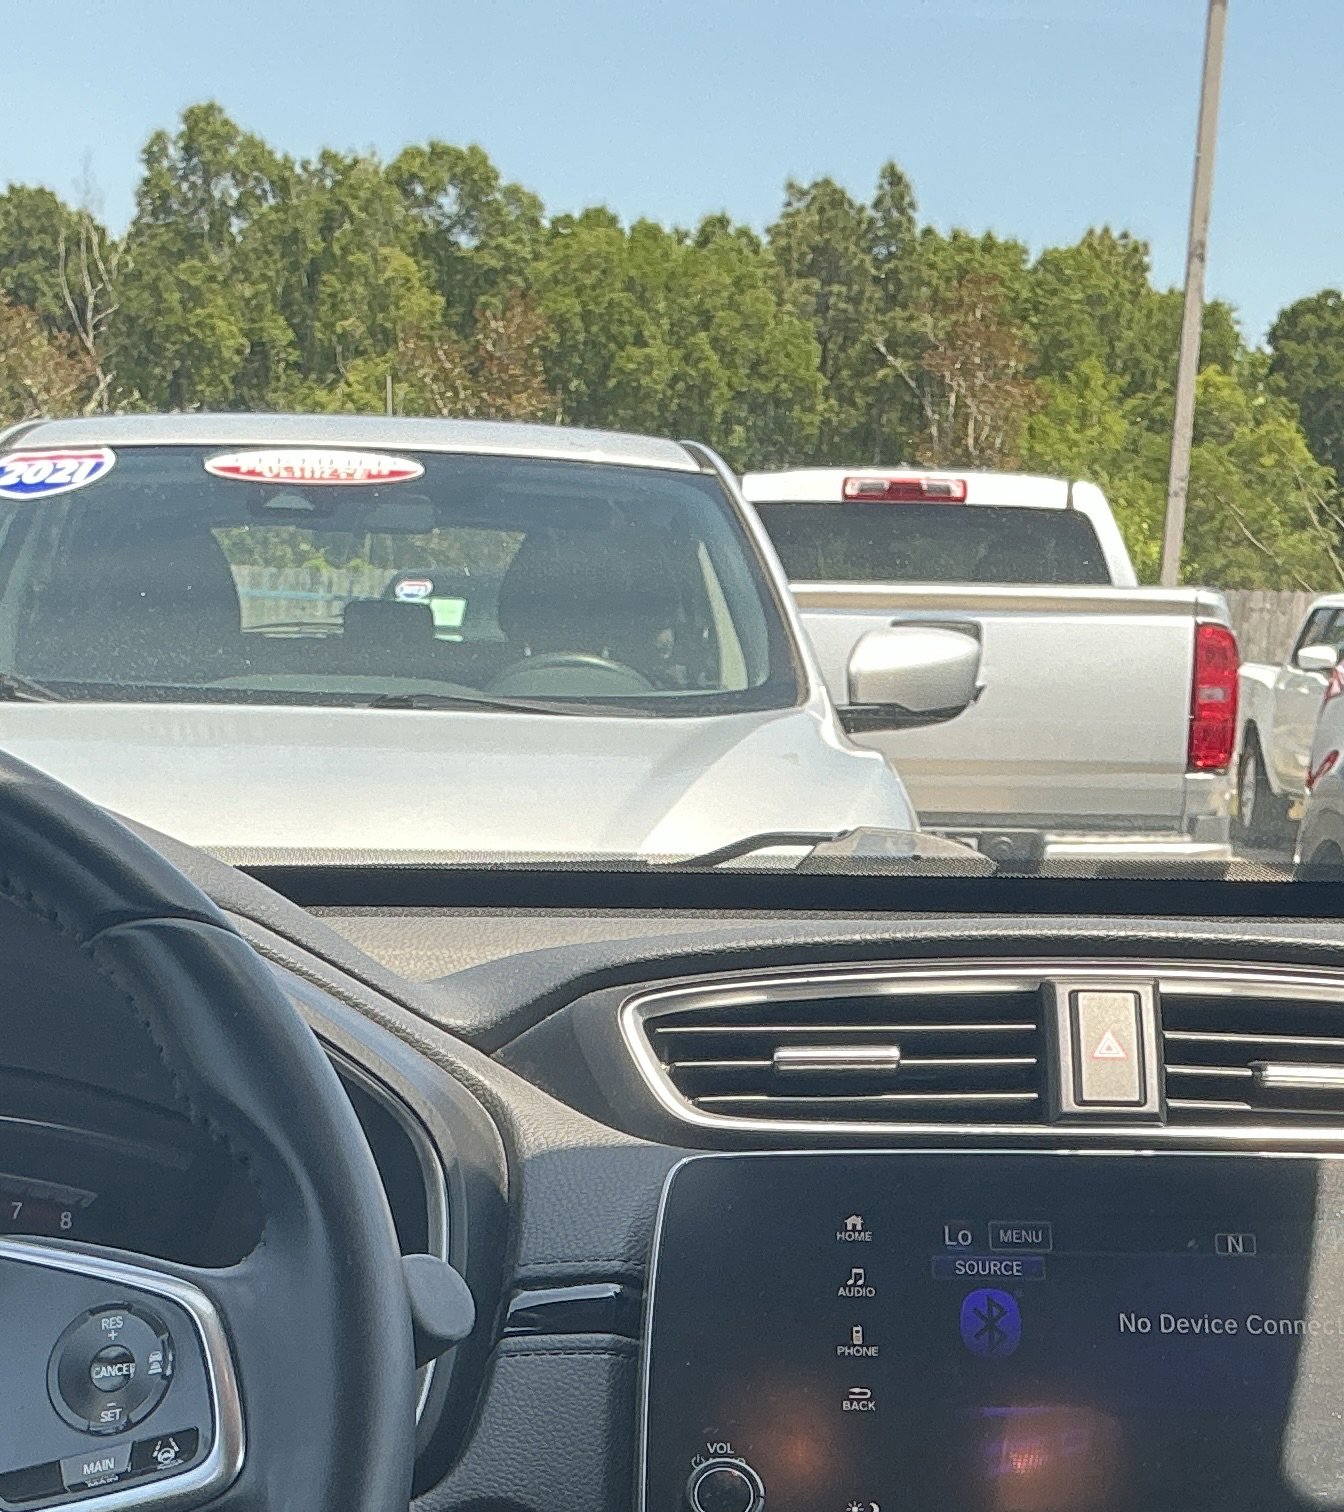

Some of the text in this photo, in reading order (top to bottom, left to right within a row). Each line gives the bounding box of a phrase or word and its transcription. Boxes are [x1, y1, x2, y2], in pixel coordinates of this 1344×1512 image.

[10, 1202, 23, 1219] 7
[60, 1211, 73, 1229] 8
[836, 1231, 872, 1243] HOME
[943, 1224, 973, 1246] Lo
[999, 1229, 1043, 1243] MENU
[1227, 1236, 1244, 1253] N
[955, 1260, 1024, 1276] SOURCE
[837, 1286, 875, 1298] AUDIO
[101, 1315, 124, 1330] RES
[1118, 1312, 1152, 1333] No
[1159, 1313, 1238, 1335] Device
[837, 1346, 879, 1357] PHONE
[842, 1400, 876, 1411] BACK
[100, 1408, 123, 1423] SET
[706, 1442, 735, 1454] VOL
[82, 1457, 115, 1475] MAIN
